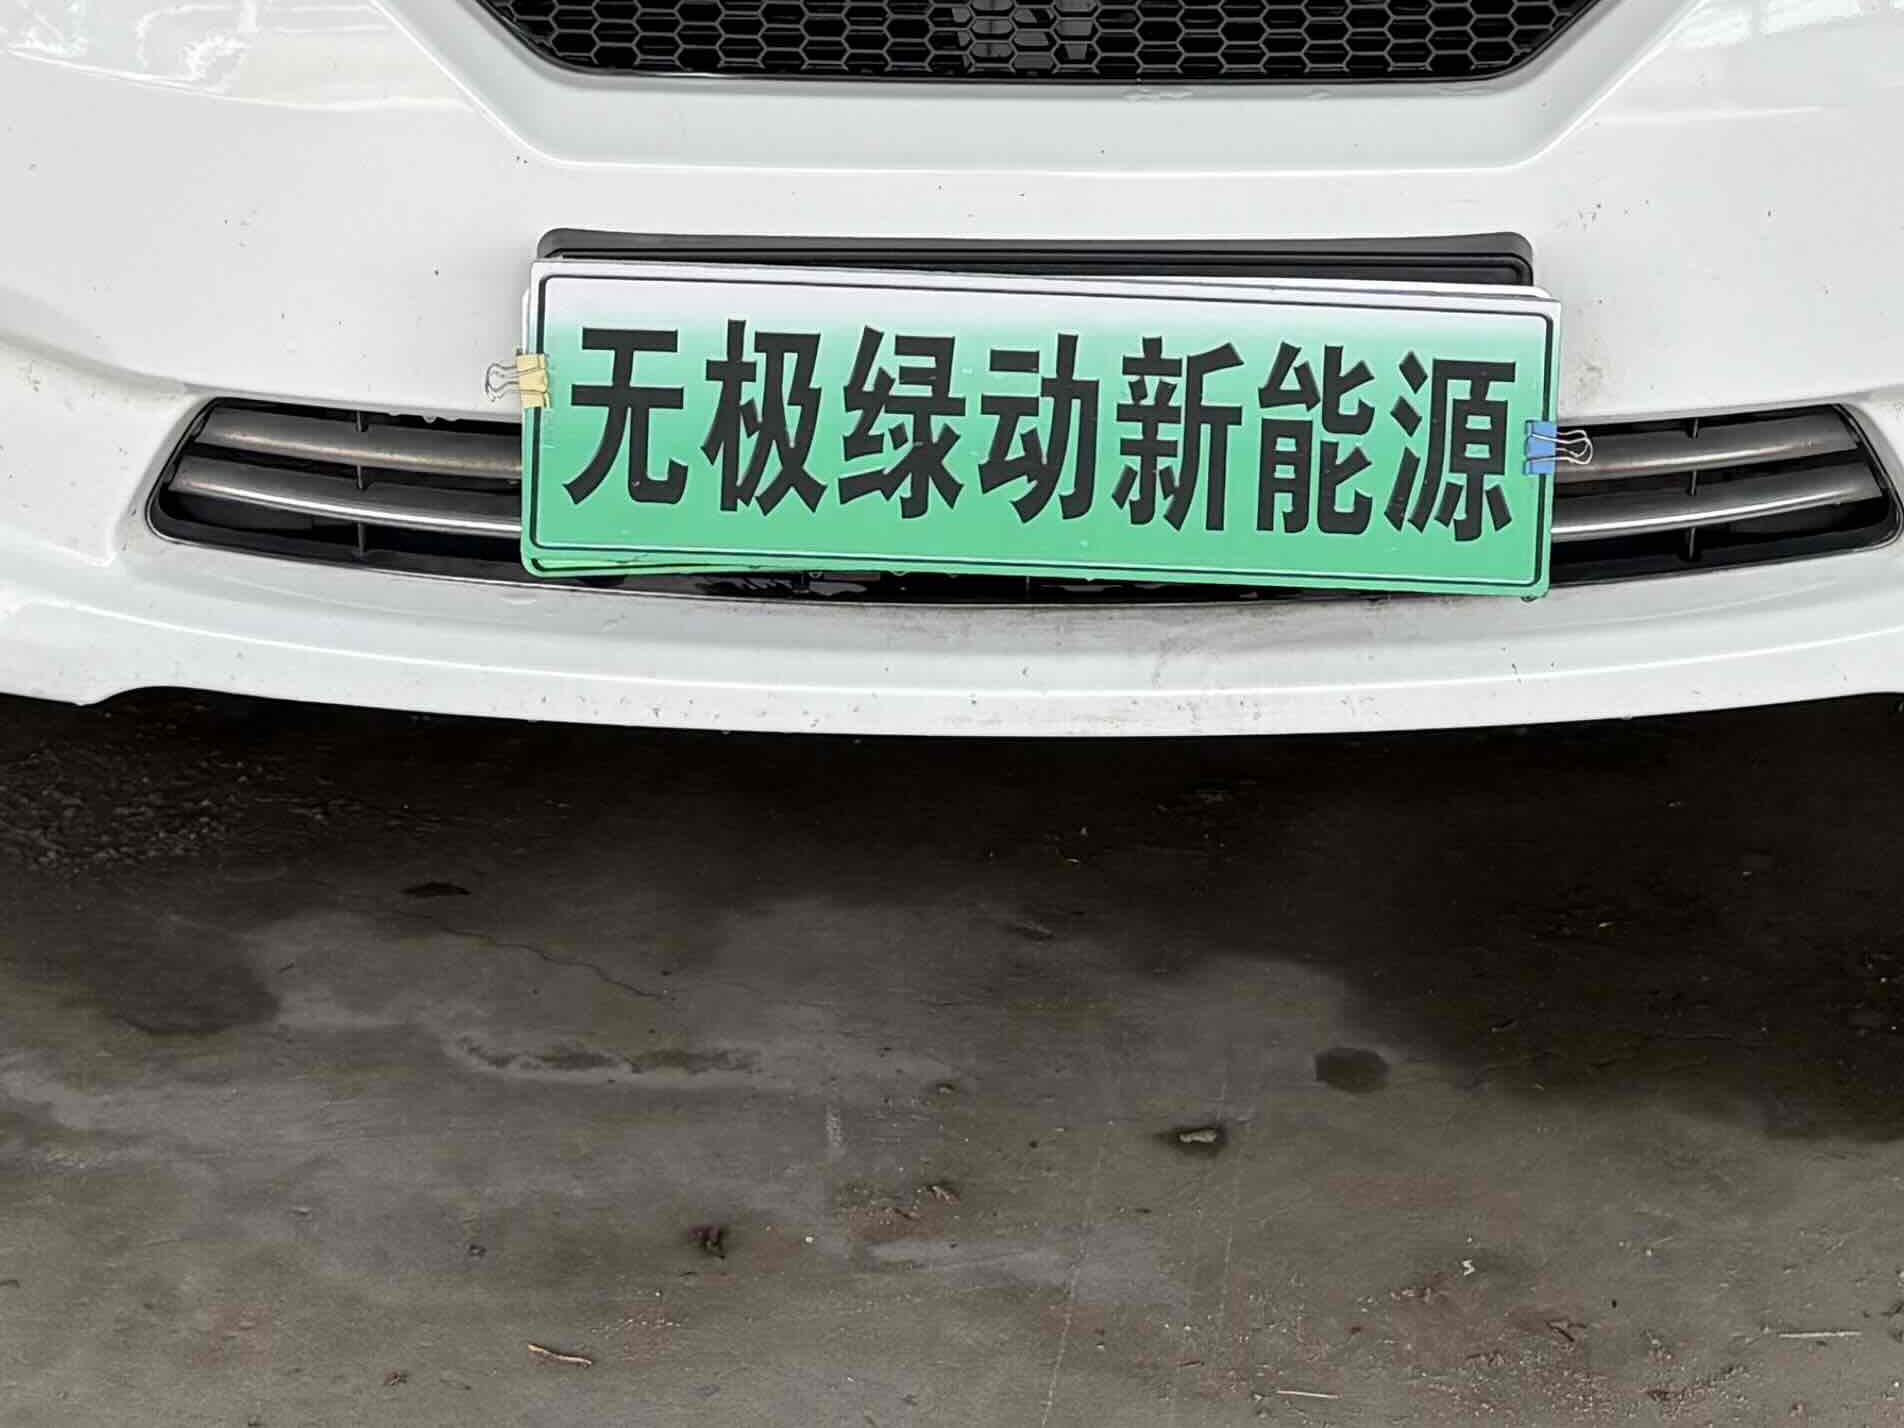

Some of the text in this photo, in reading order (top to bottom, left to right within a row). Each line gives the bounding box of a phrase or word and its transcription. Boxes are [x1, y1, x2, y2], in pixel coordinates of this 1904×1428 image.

[562, 318, 1518, 542] 无极绿动新能源
